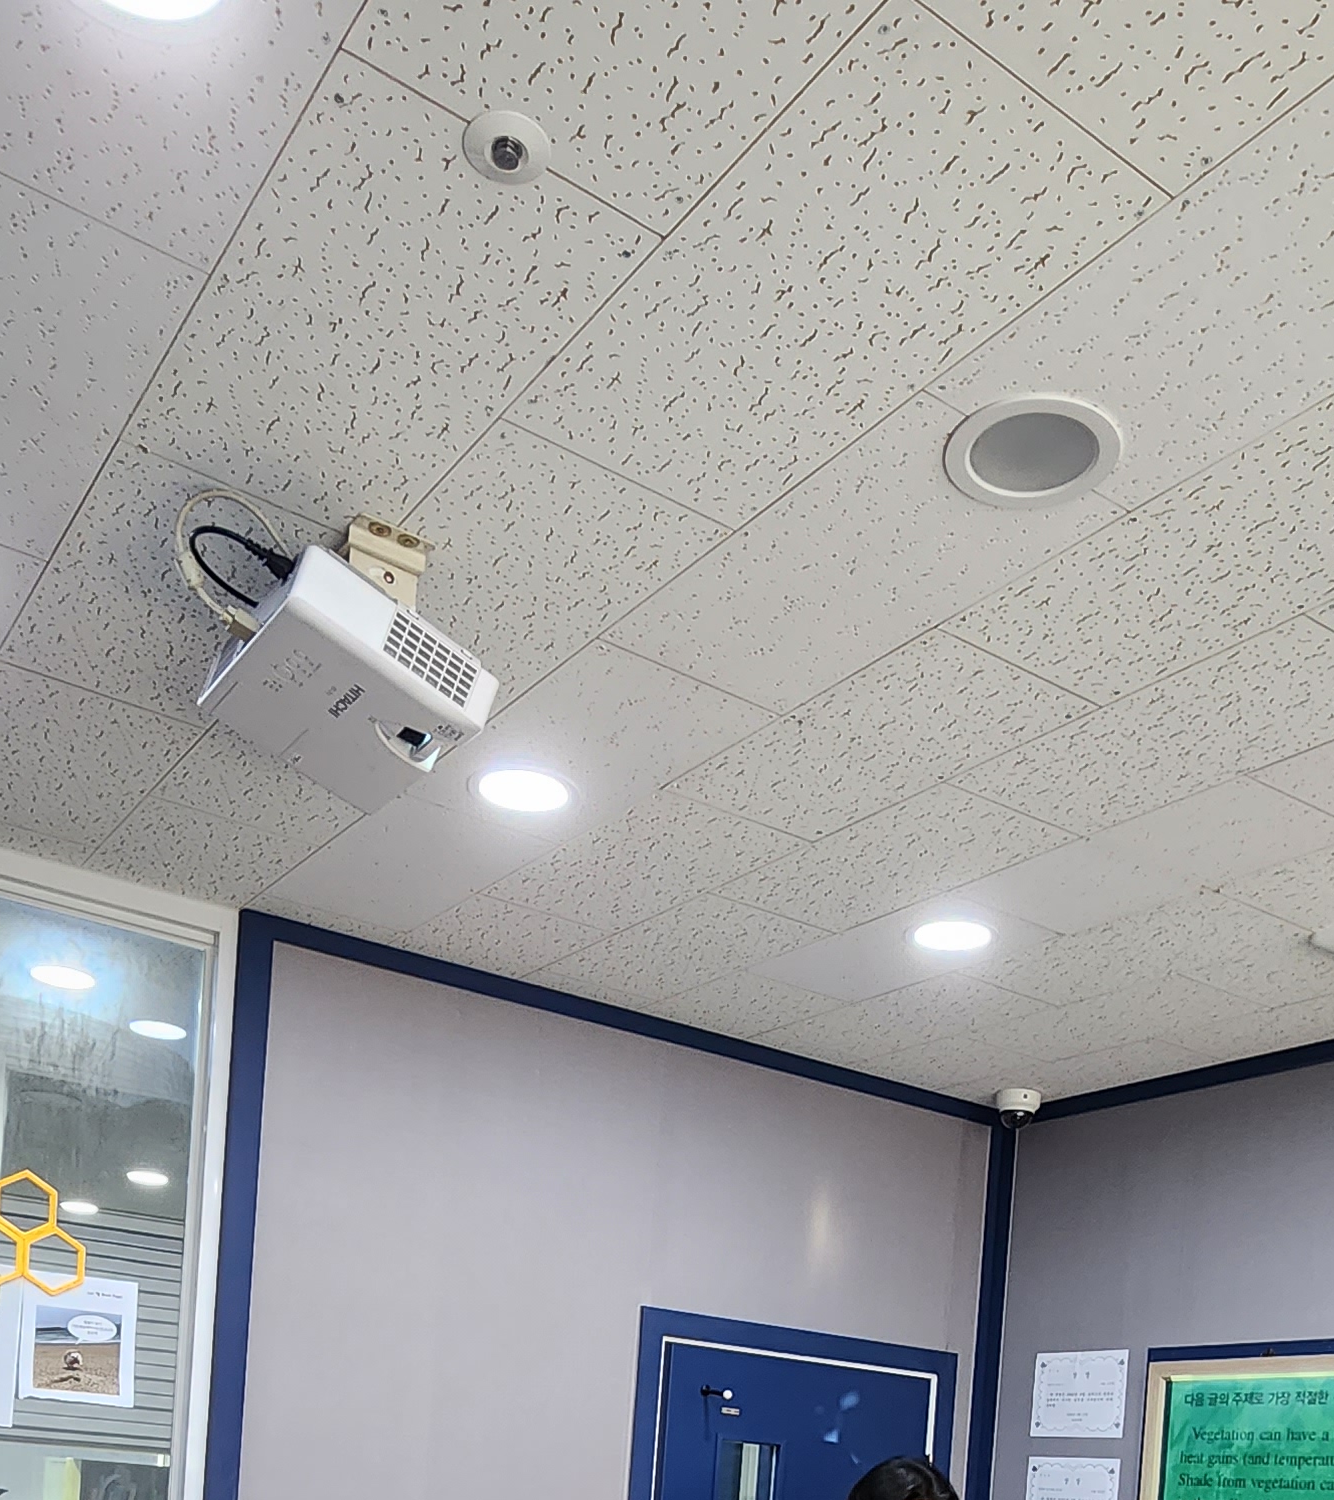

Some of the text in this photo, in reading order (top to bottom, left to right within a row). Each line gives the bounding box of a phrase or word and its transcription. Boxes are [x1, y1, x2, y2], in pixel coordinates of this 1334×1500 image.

[327, 683, 366, 719] HITACHI
[1185, 1392, 1203, 1406] 다음
[1208, 1393, 1228, 1406] 글의
[1232, 1392, 1264, 1406] 주제로
[1268, 1392, 1290, 1405] 가장
[1295, 1391, 1329, 1405] 적절한
[1192, 1428, 1254, 1443] Vegetation
[1260, 1431, 1281, 1441] can
[1286, 1430, 1316, 1442] have
[1322, 1432, 1329, 1442] a
[1180, 1453, 1203, 1465] heat
[1207, 1454, 1239, 1468] gains
[1243, 1454, 1270, 1466] (and
[1178, 1474, 1213, 1488] Shade
[1217, 1475, 1246, 1488] from
[1251, 1477, 1314, 1492] vegetation
